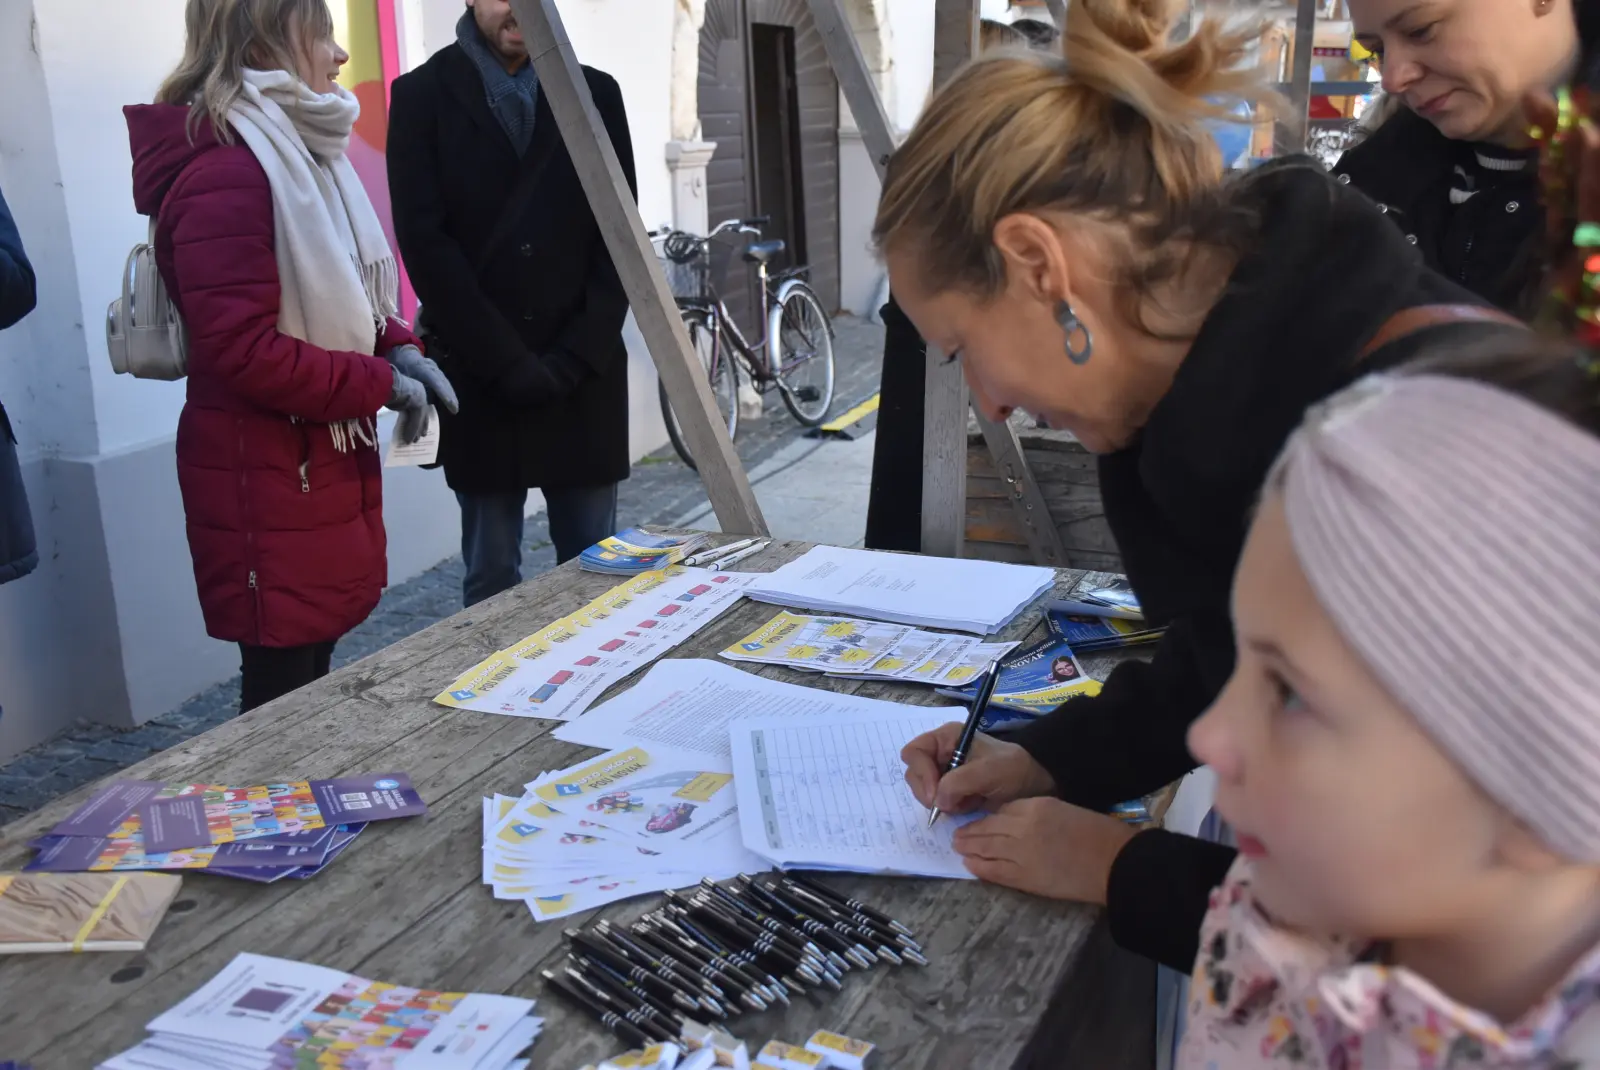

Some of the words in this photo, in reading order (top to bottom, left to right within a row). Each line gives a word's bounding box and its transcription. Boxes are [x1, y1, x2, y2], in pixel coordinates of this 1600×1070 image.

[1010, 651, 1046, 670] NOVAK
[588, 775, 614, 789] POU
[610, 762, 648, 779] NOVAK
